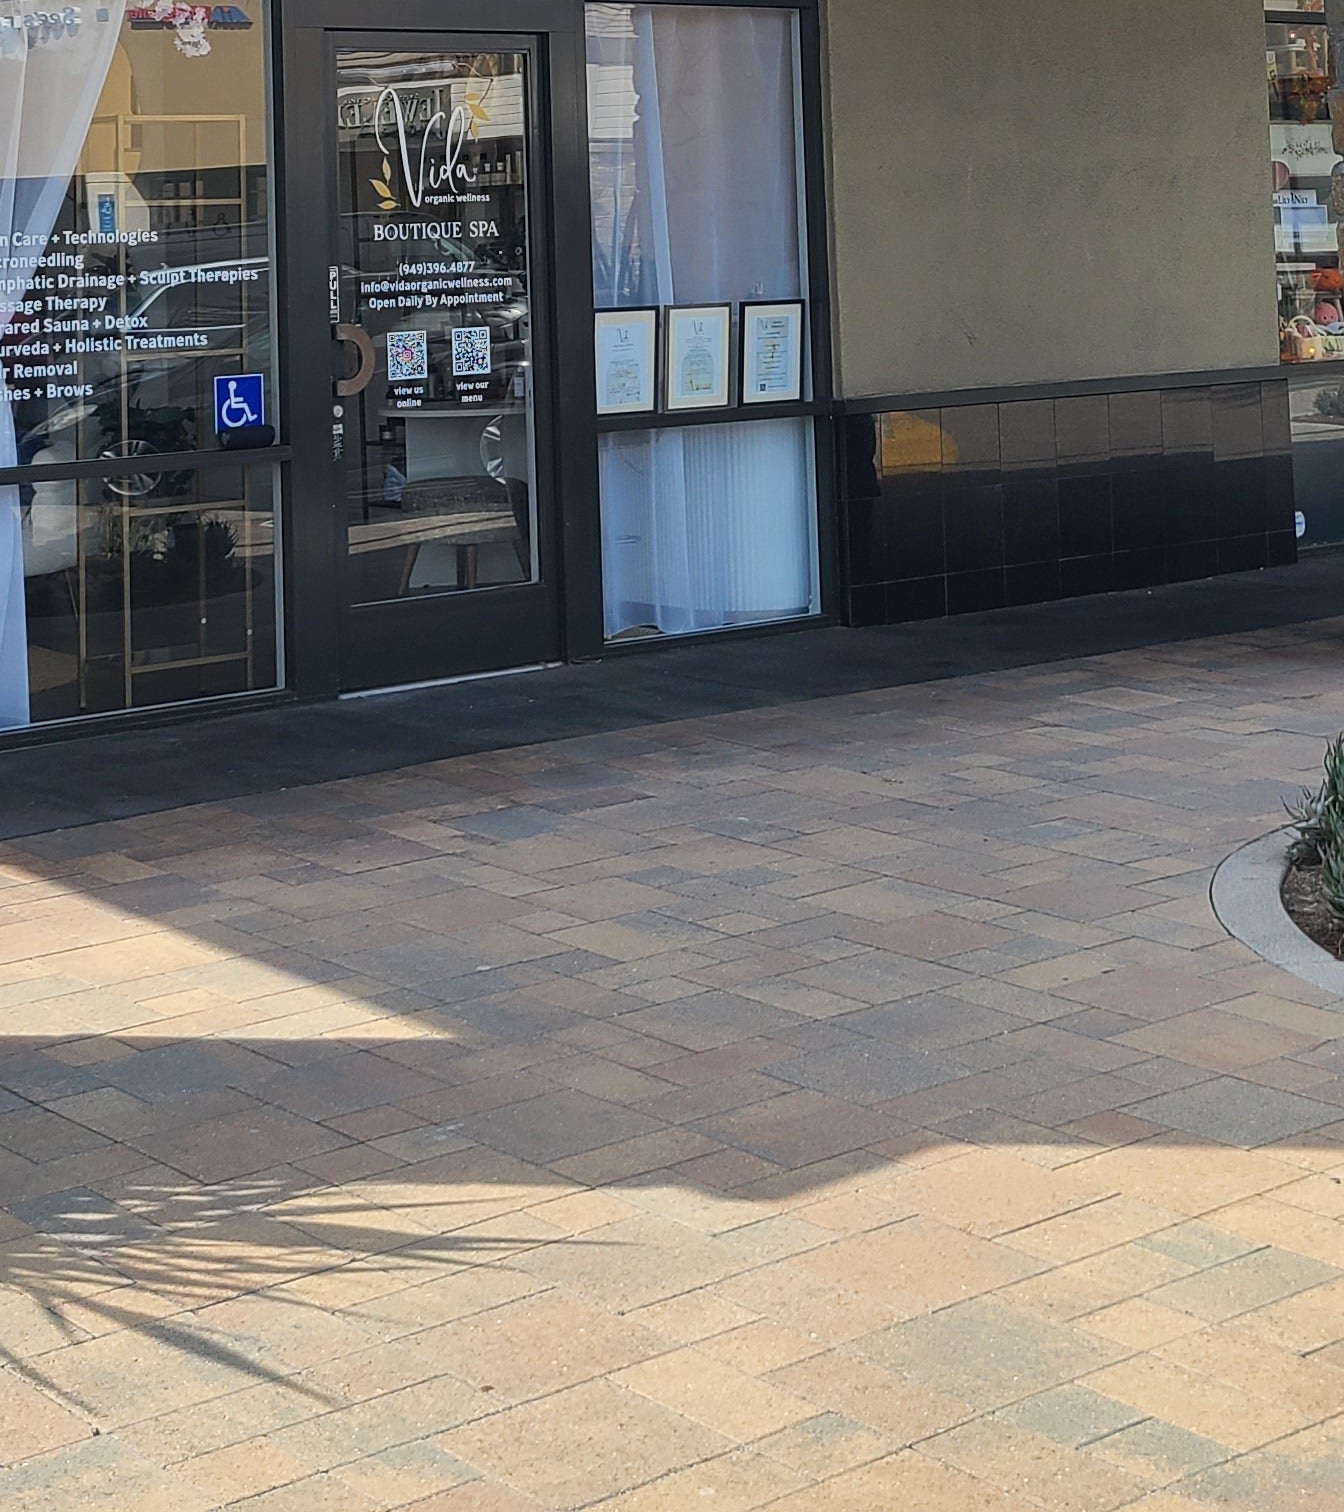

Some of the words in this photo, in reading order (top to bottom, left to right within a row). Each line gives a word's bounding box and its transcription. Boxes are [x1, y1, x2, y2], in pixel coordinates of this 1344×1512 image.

[375, 88, 477, 208] Vida
[424, 193, 455, 205] organic
[456, 192, 490, 203] wellness
[12, 231, 48, 247] Care
[62, 228, 159, 246] Technologies
[373, 221, 462, 241] BOUTIQUE
[469, 220, 499, 237] SPA
[57, 273, 125, 290] Drainage
[139, 270, 186, 287] Sculpt
[188, 267, 259, 285] Therapies
[360, 277, 513, 294] info@vidaorganicwellness.com
[329, 271, 338, 310] PULL
[45, 296, 107, 312] Therapy
[368, 297, 396, 311] Open
[397, 295, 424, 309] Daily
[425, 294, 438, 308] By
[439, 291, 504, 307] Appointment
[43, 318, 89, 333] Sauna
[104, 315, 148, 329] Detox
[65, 337, 122, 354] Holistic
[124, 333, 208, 350] Treatments
[13, 360, 78, 379] Removal
[46, 384, 94, 399] Brows
[394, 386, 413, 396] view
[414, 386, 424, 395] us
[456, 381, 474, 391] view
[475, 381, 490, 389] our
[396, 398, 422, 408] online
[461, 394, 483, 403] menu
